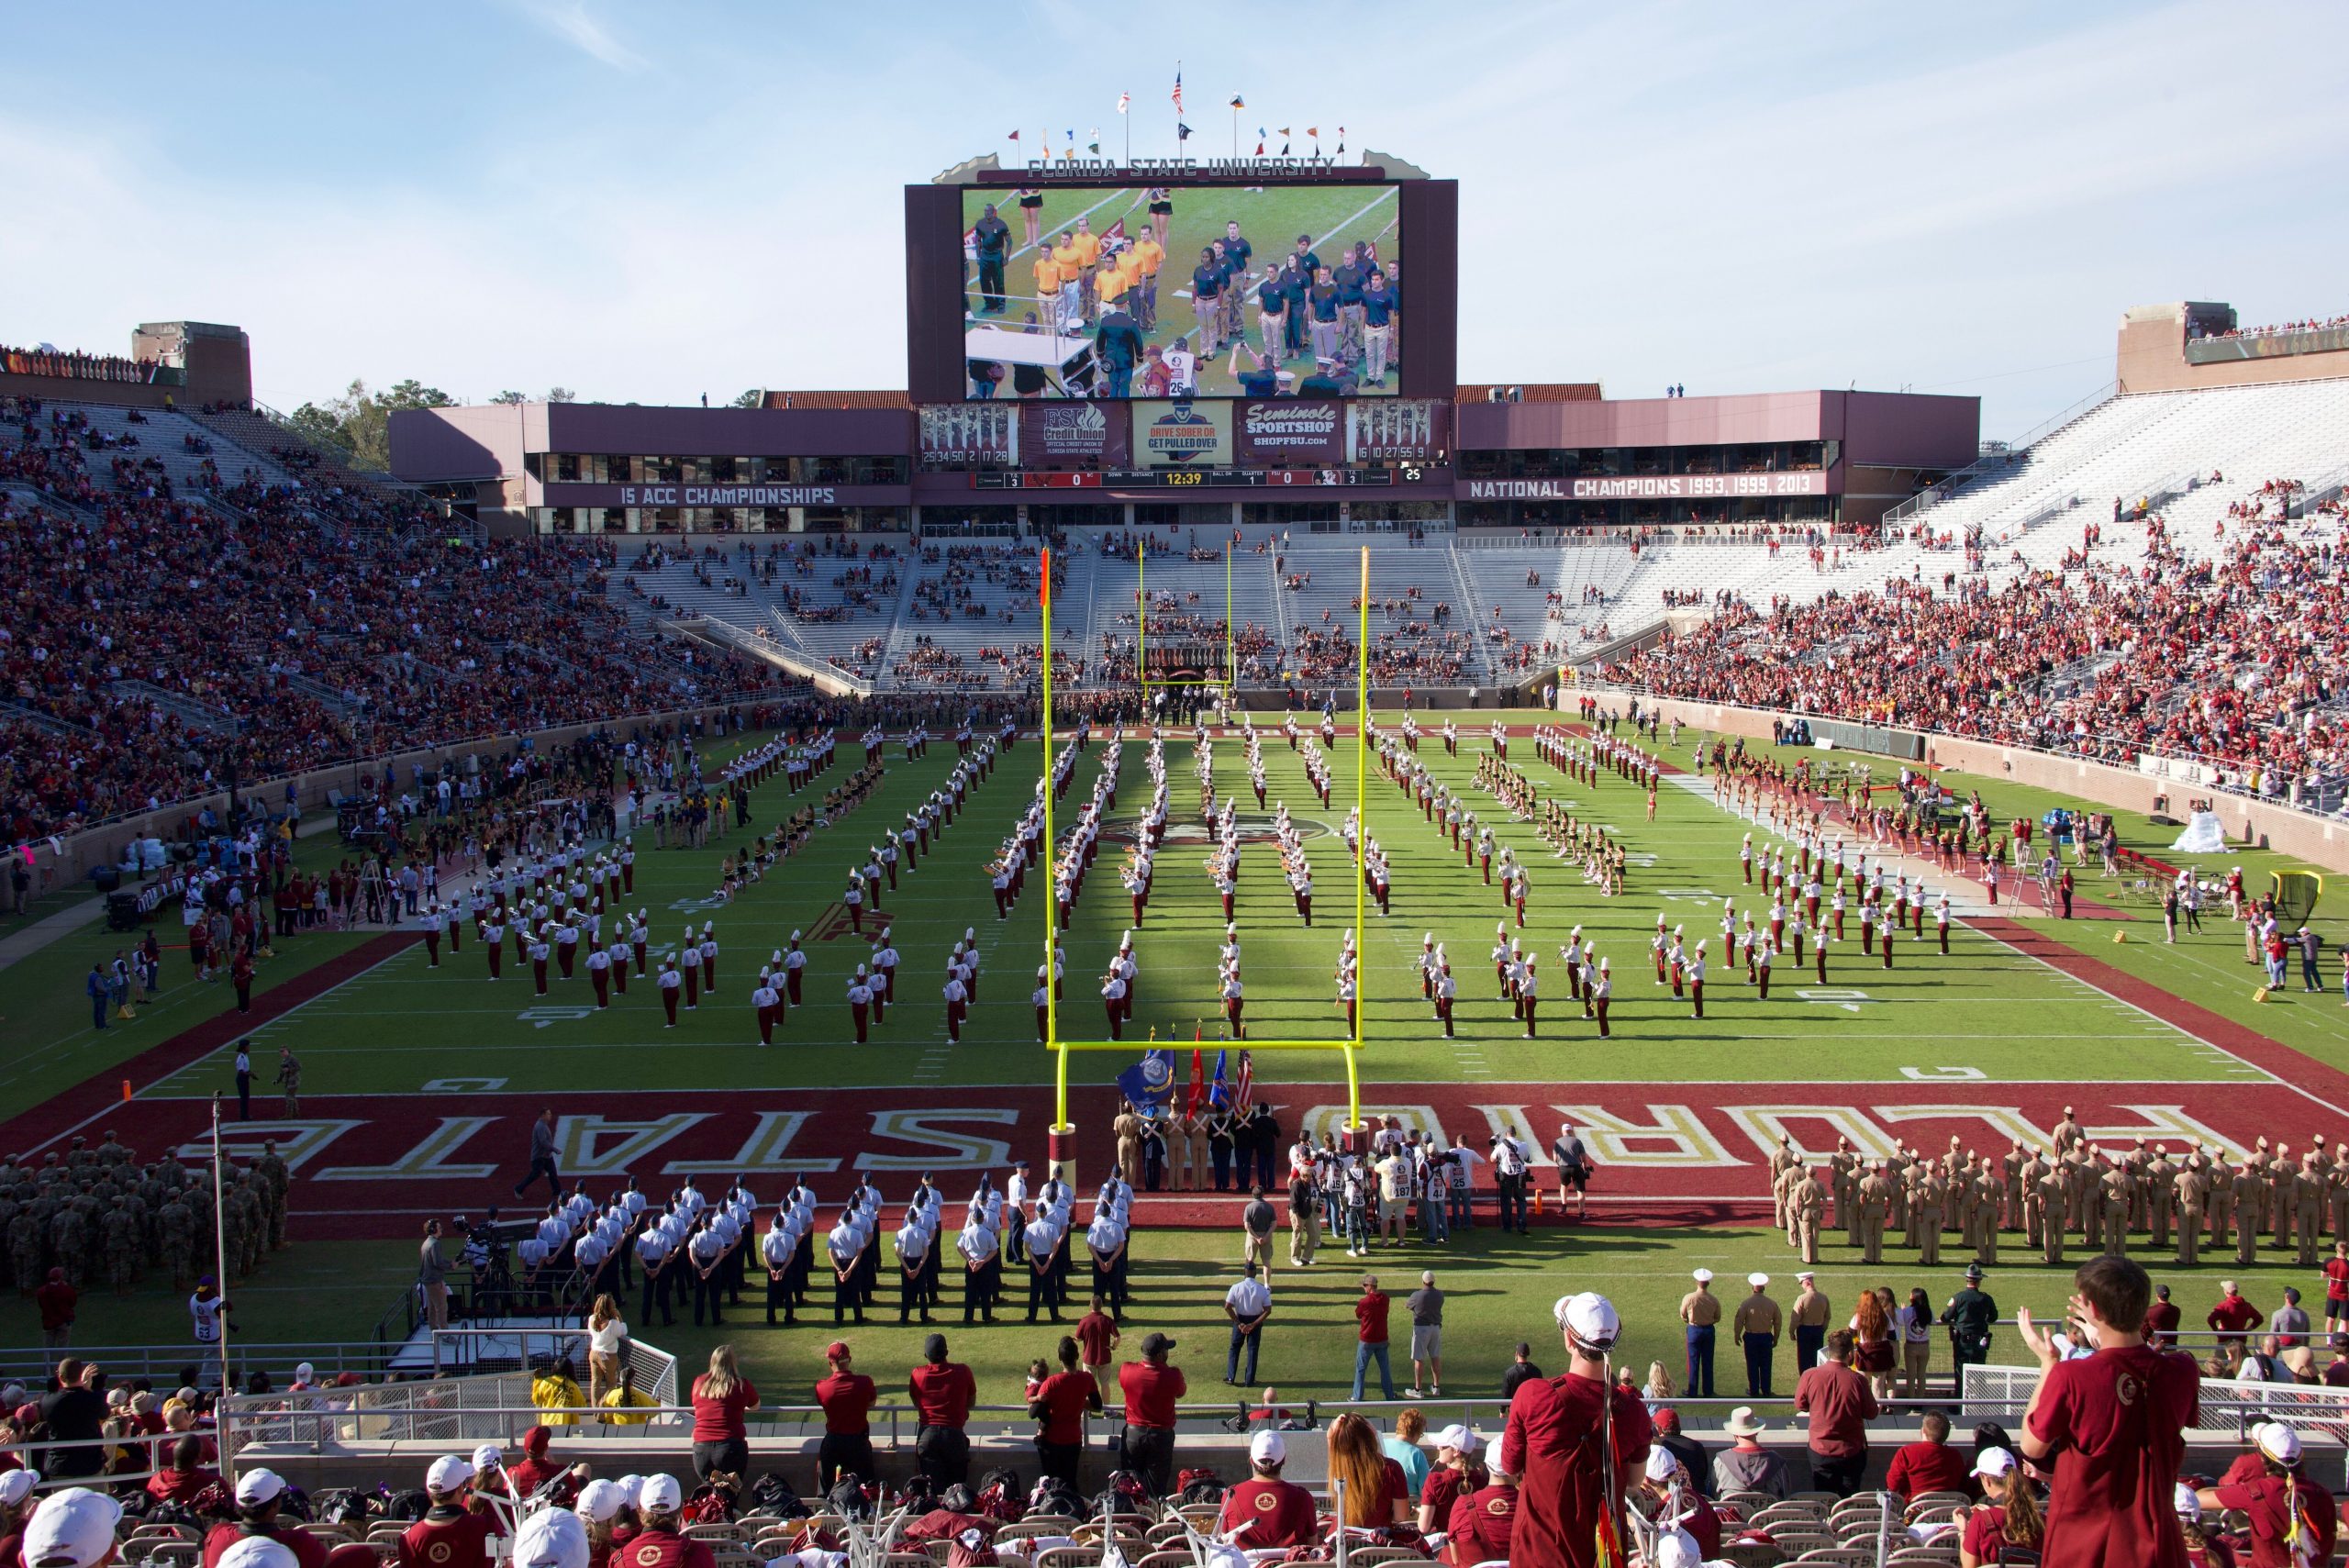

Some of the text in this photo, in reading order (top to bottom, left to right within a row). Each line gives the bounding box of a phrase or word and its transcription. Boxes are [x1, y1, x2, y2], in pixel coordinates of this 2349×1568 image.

[1027, 157, 1336, 178] FLORIDA STATE UNIVERSITY
[1170, 382, 1184, 394] 26
[1245, 404, 1336, 424] Seminole
[1044, 428, 1105, 439] Credit Union
[1150, 427, 1216, 438] DRIVE SOBER OR
[1247, 421, 1335, 434] SPORTSHOP
[1149, 438, 1218, 449] GET PULLED OVER
[923, 450, 1008, 462] 25 34 50 2 17 28
[1359, 447, 1424, 458] 16 10 27 55 9
[1073, 473, 1081, 486] 0
[1166, 473, 1202, 485] 12:39
[1249, 476, 1254, 485] 1
[1284, 472, 1292, 484] 0
[1350, 475, 1356, 484] 3
[1406, 468, 1420, 481] 25
[1011, 478, 1018, 487] 3
[1470, 475, 1811, 498] NATIONAL CHAMPIONS 1993, 1999, 2013
[621, 487, 835, 505] 15 ACC CHAMPIONSHIPS
[1508, 1163, 1522, 1173] 179
[1453, 1178, 1465, 1188] 25
[1395, 1186, 1410, 1197] 187
[1046, 1555, 1099, 1568] CHIEF
